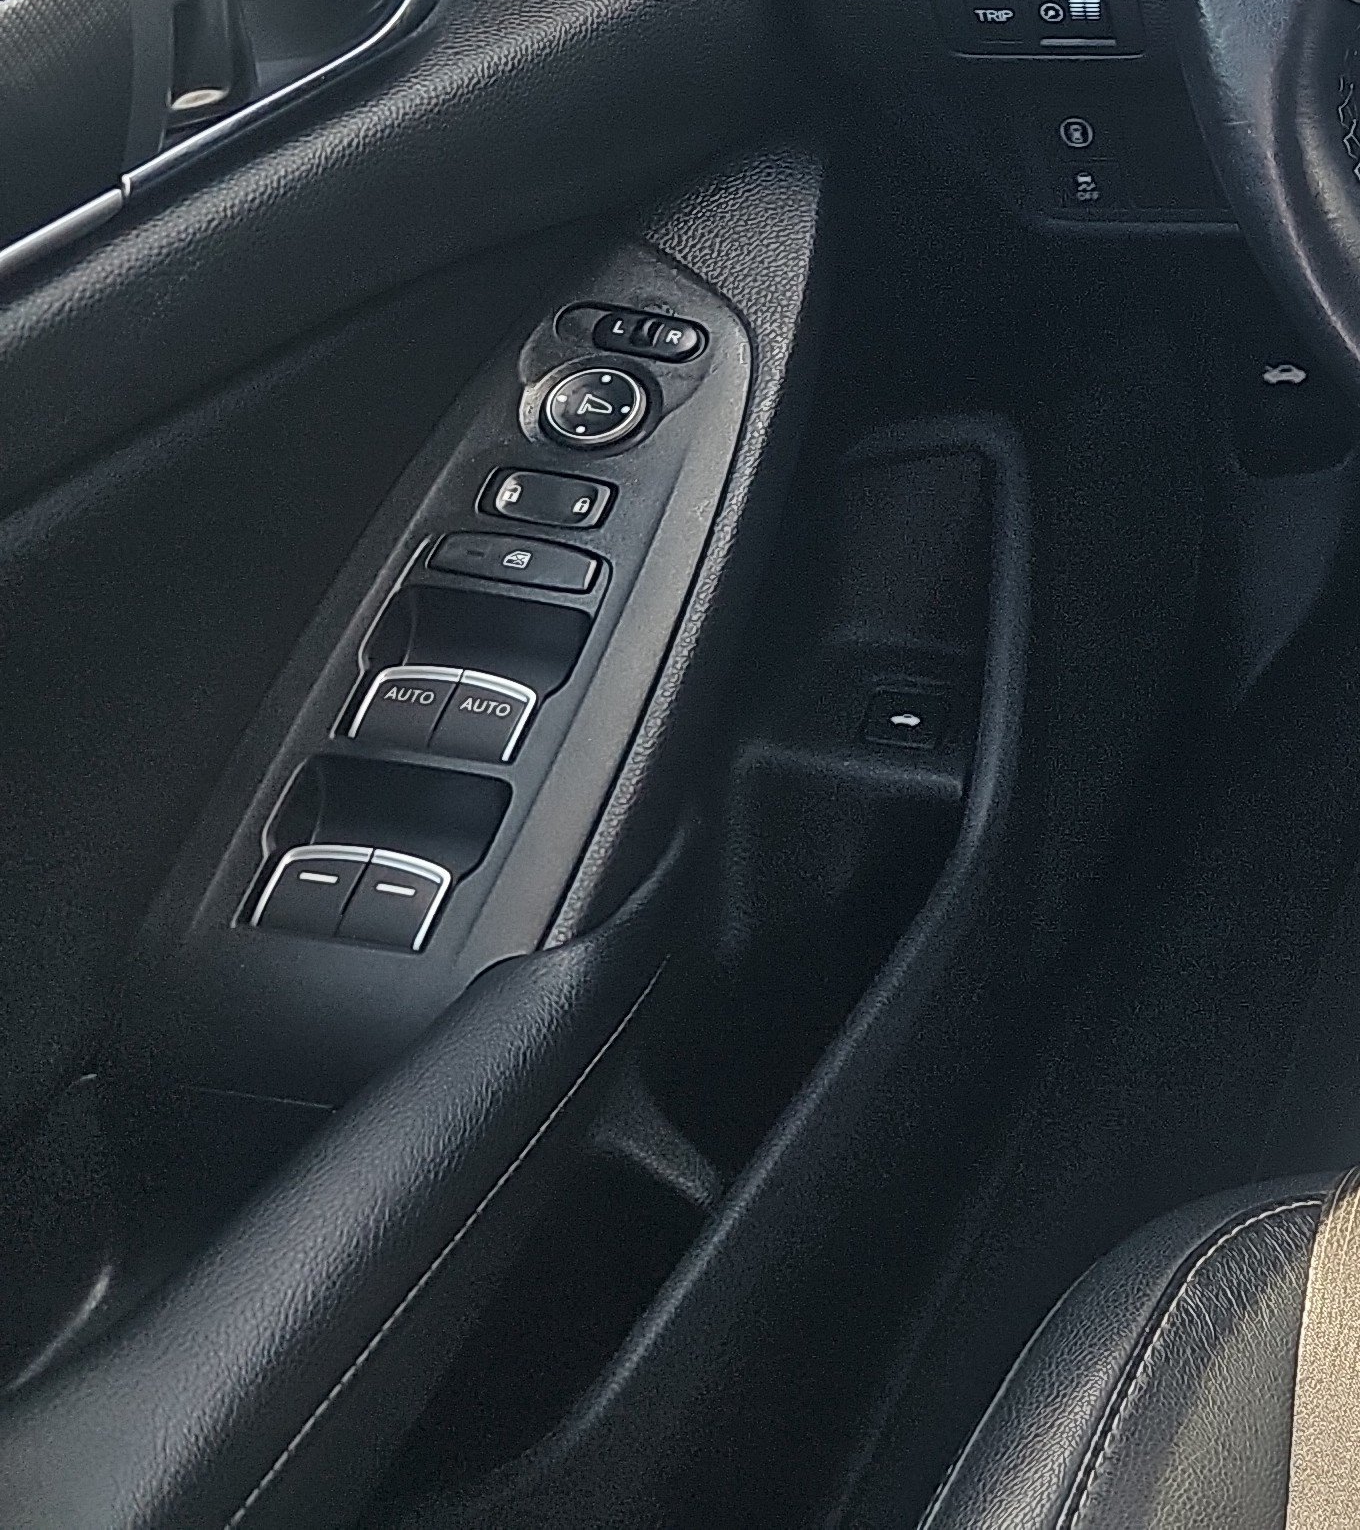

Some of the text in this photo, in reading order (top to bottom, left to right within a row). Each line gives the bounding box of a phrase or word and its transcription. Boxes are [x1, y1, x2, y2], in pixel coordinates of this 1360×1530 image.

[974, 10, 1014, 23] TRIP
[613, 320, 624, 334] L
[667, 330, 683, 345] R
[384, 684, 435, 706] AUTO
[460, 696, 511, 719] AUTO
